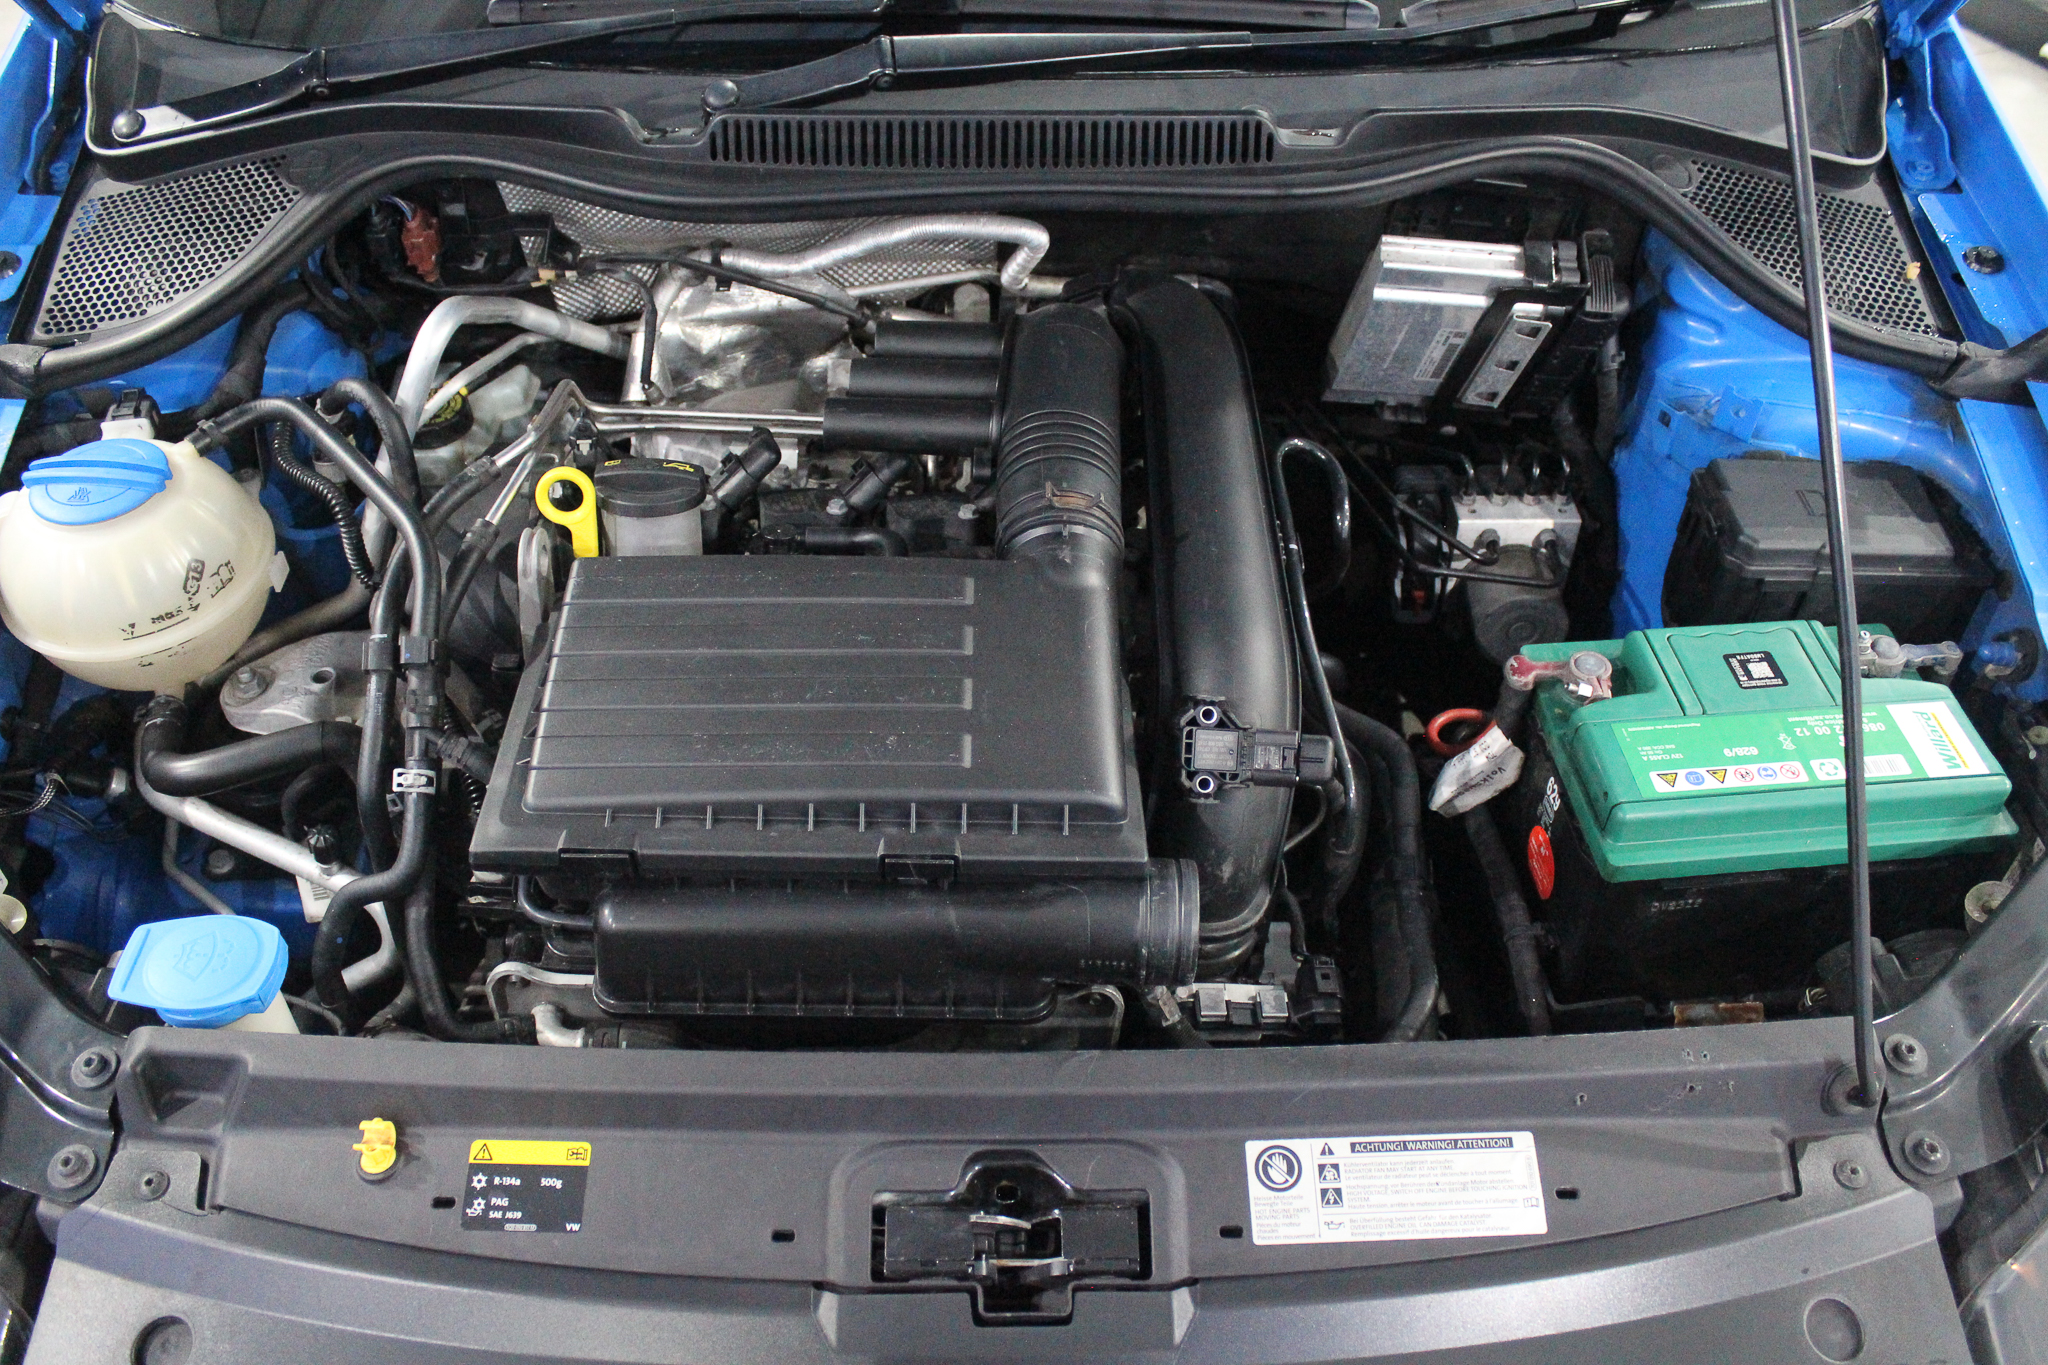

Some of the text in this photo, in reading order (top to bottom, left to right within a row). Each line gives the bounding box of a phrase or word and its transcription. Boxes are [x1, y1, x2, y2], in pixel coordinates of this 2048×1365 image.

[1794, 727, 1810, 736] 12
[1814, 726, 1831, 735] 00
[1912, 710, 1962, 770] Willard
[1723, 746, 1759, 757] 628/9
[1355, 1138, 1510, 1152] ACHTUNG! WARNING! ATTENTION!
[494, 1177, 562, 1189] R-134a 500g
[491, 1198, 509, 1206] PAG
[505, 1211, 522, 1219] J639
[566, 1223, 581, 1231] VW
[1351, 1230, 1386, 1238] Remplissage
